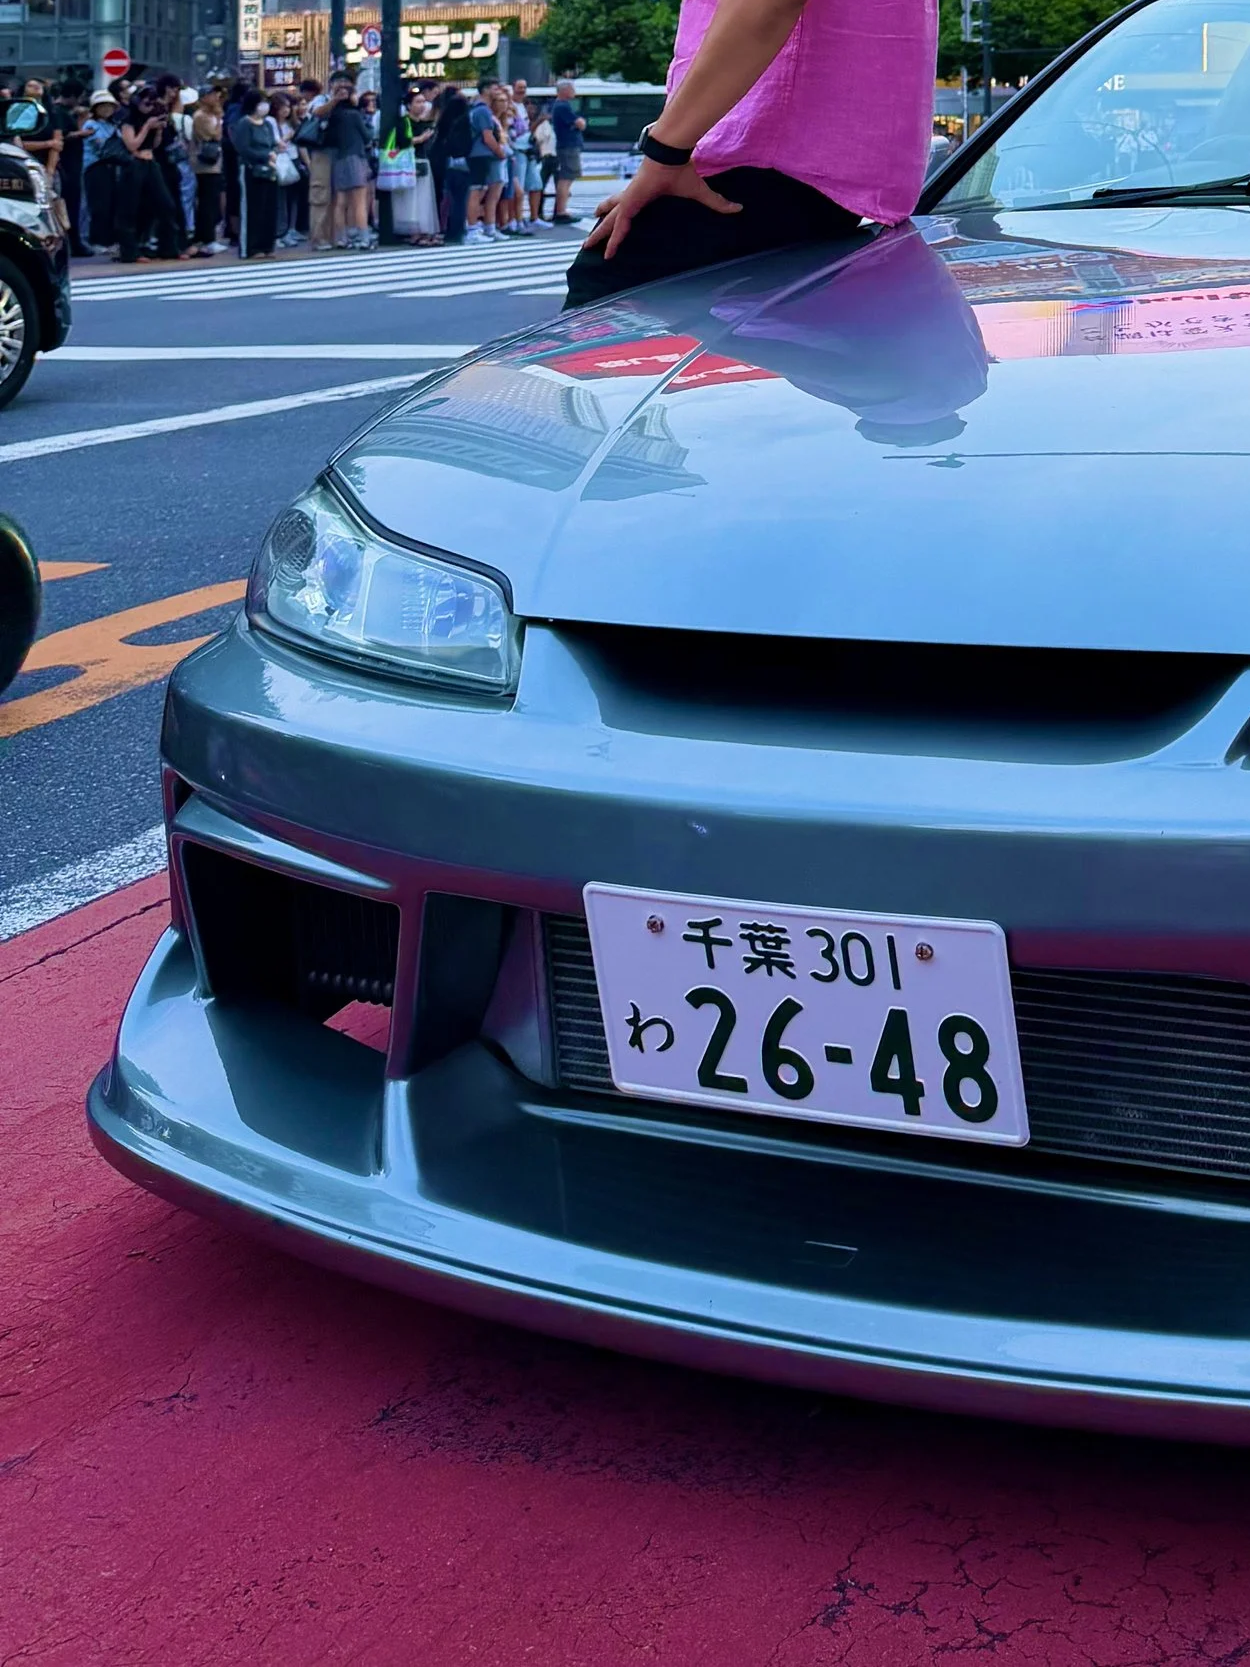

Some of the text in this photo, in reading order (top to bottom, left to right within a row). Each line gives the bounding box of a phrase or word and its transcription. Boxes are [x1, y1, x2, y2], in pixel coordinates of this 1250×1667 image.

[342, 20, 502, 64] サドラッグ
[682, 916, 903, 991] 千葉 301
[624, 985, 999, 1124] わ 26-48
